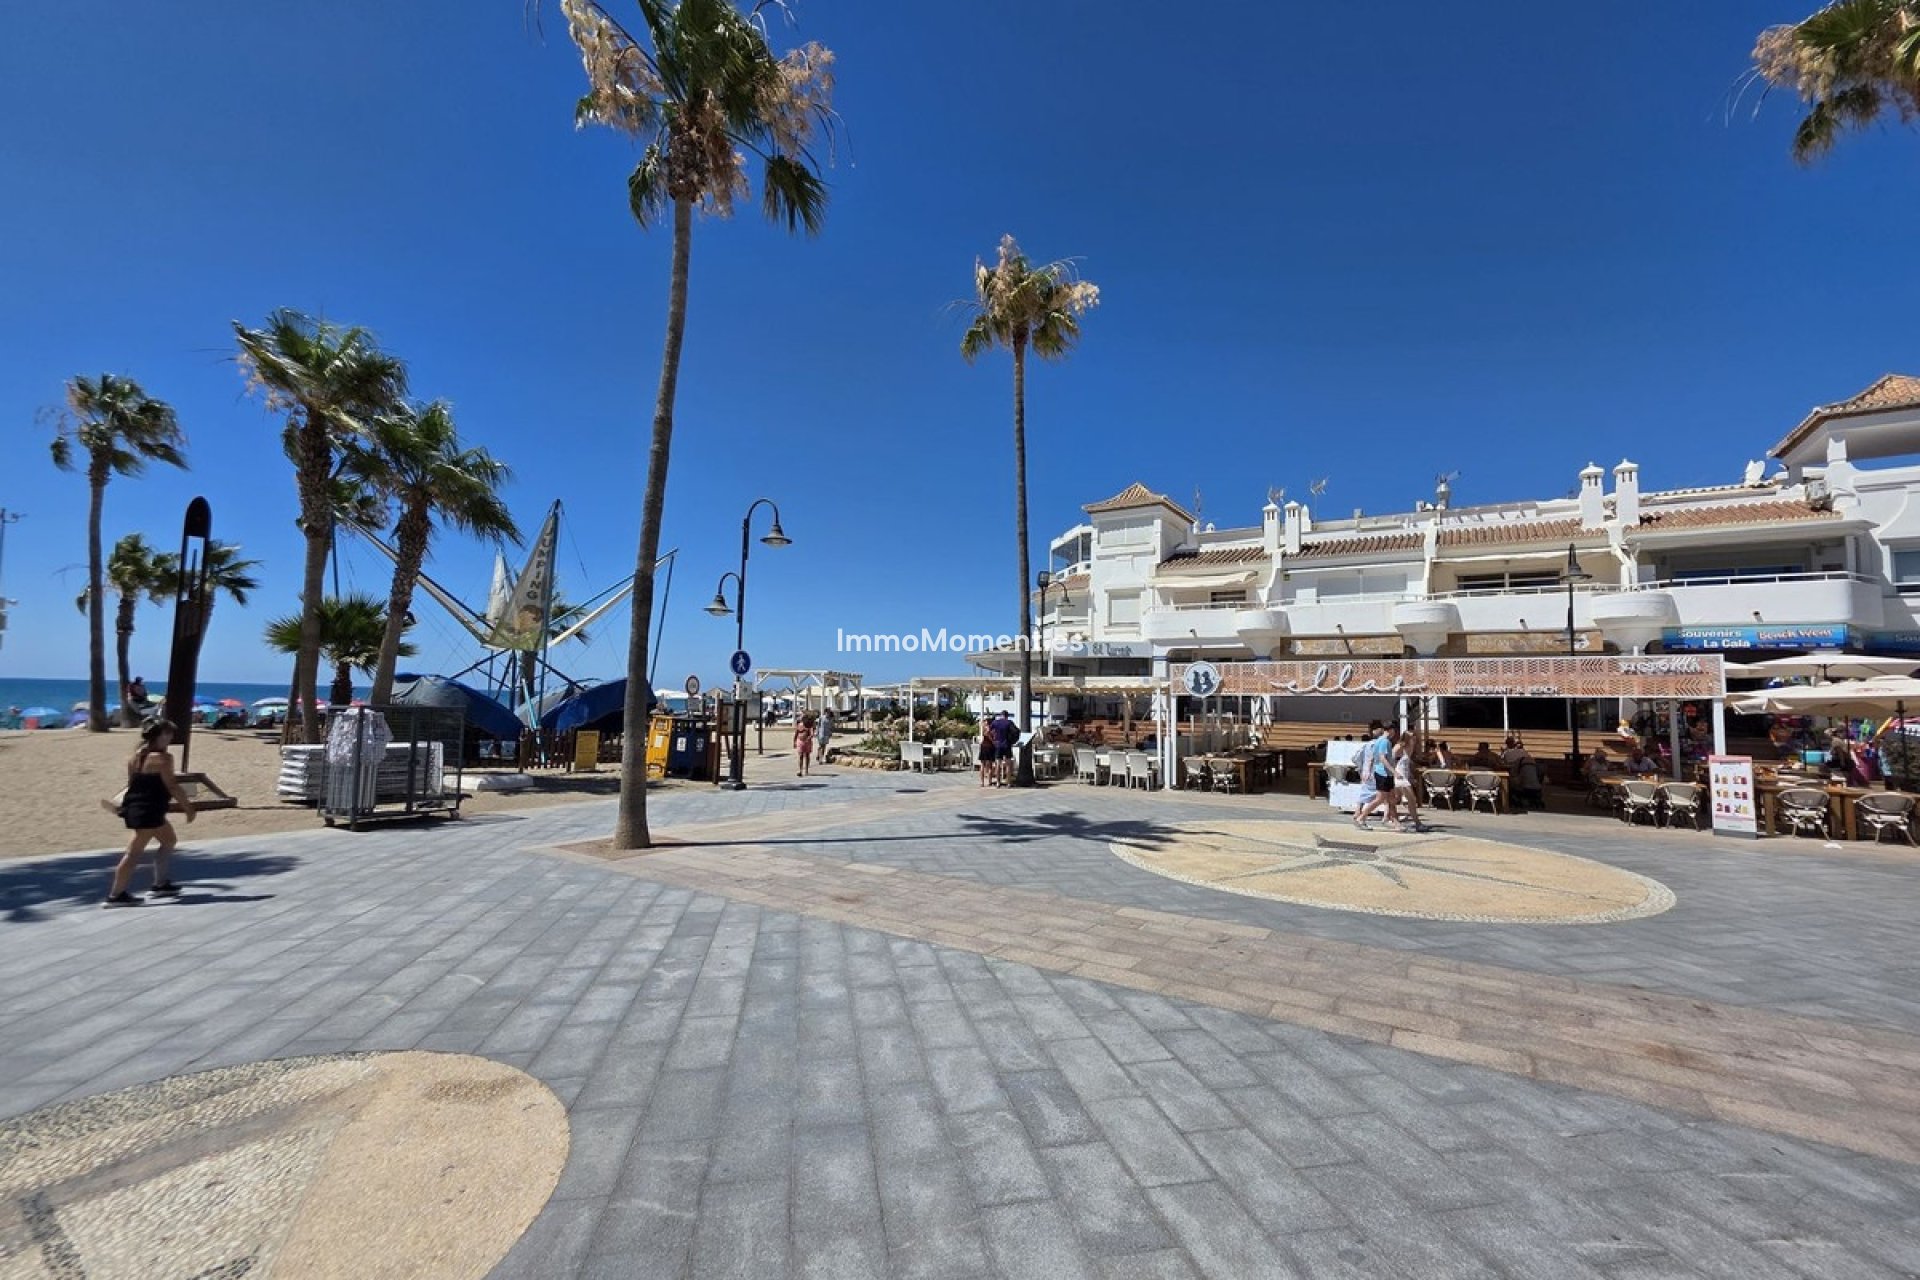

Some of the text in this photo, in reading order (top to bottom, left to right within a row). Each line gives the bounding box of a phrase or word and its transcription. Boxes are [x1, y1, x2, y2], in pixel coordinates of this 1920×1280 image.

[1679, 628, 1742, 638] Souvenirs
[1703, 639, 1718, 649] La
[1722, 639, 1751, 649] Cala
[1270, 664, 1427, 694] ellas
